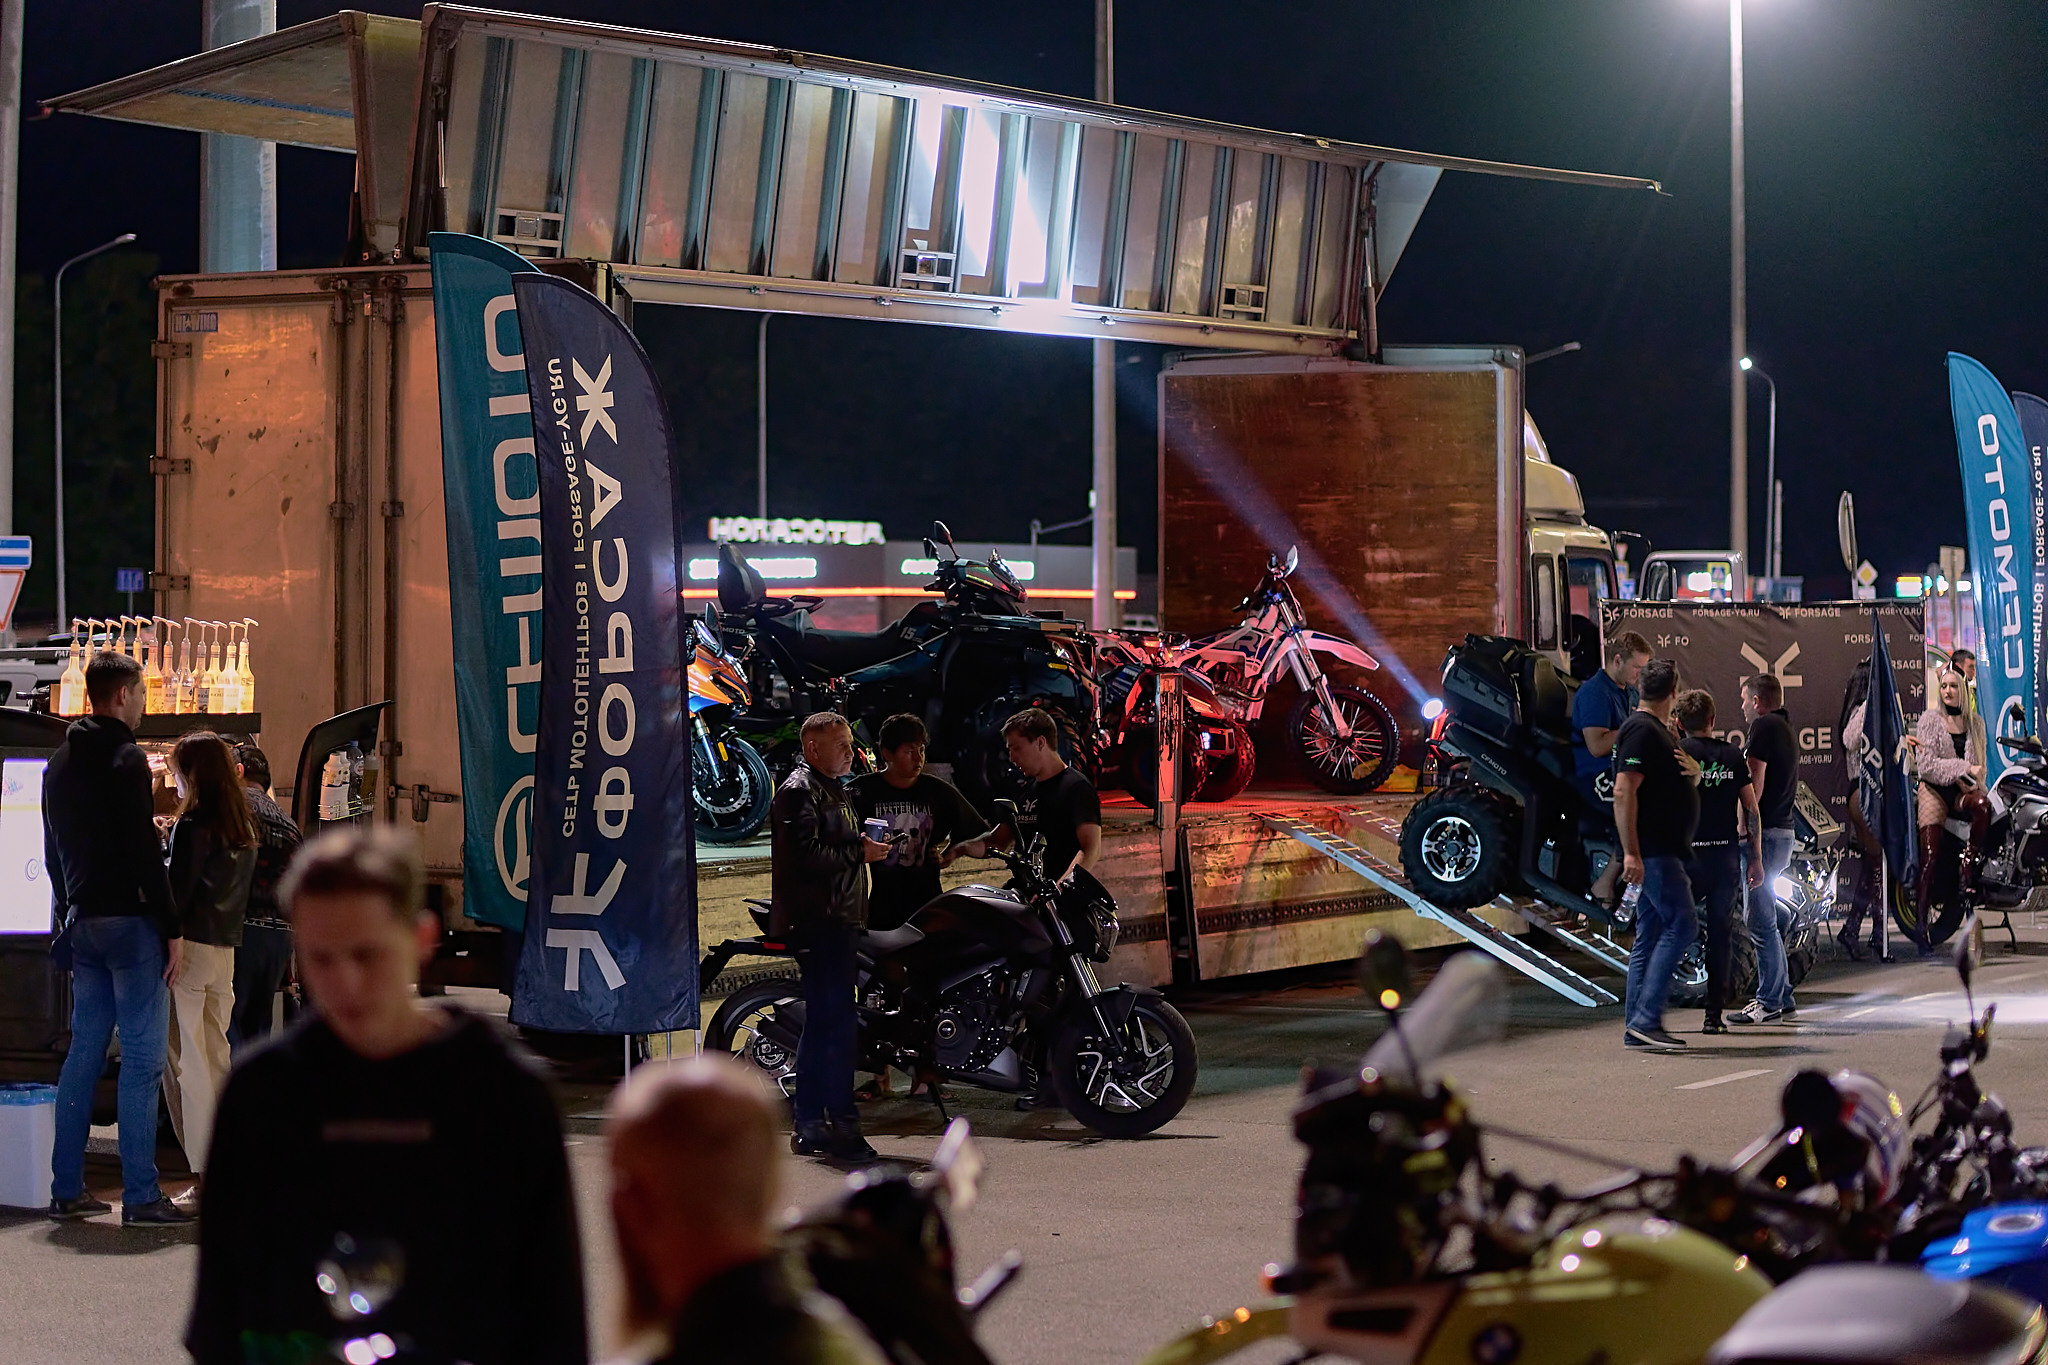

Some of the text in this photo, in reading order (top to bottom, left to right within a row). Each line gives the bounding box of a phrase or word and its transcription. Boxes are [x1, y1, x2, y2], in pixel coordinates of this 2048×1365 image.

[1623, 608, 1673, 618] FORSAGE
[1795, 607, 1841, 618] FORSAGE
[1892, 660, 1922, 670] RSAGE
[1480, 753, 1508, 776] CFMOTO
[1700, 770, 1734, 780] RSAGE
